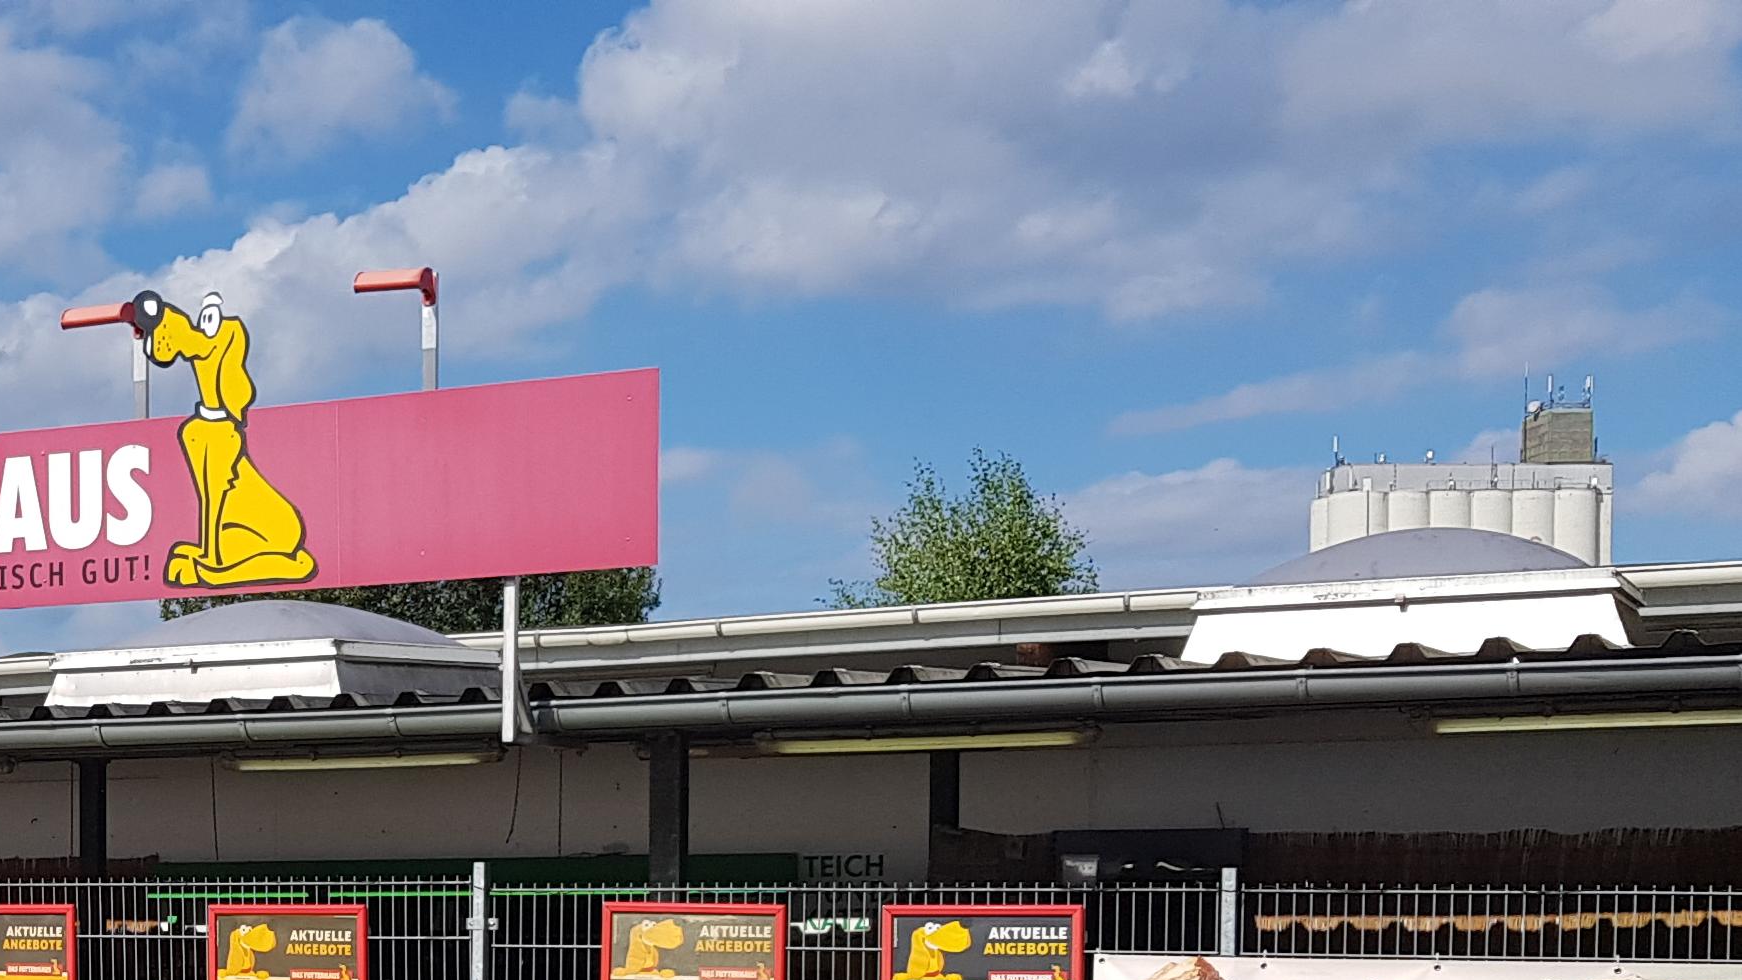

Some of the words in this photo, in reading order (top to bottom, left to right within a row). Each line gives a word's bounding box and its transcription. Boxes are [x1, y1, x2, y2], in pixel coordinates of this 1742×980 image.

[82, 555, 151, 584] GUT!
[803, 855, 884, 878] TEICH
[6, 926, 63, 938] AKTUELLE
[290, 929, 352, 942] AKTUELLE
[699, 925, 772, 938] AKTUELLE
[988, 926, 1068, 940] AKTUELLE
[2, 938, 63, 951] ANGEBOTE
[285, 943, 352, 956] ANGEBOTE
[695, 940, 772, 953] ANGEBOTE
[983, 942, 1068, 956] ANGEBOTE
